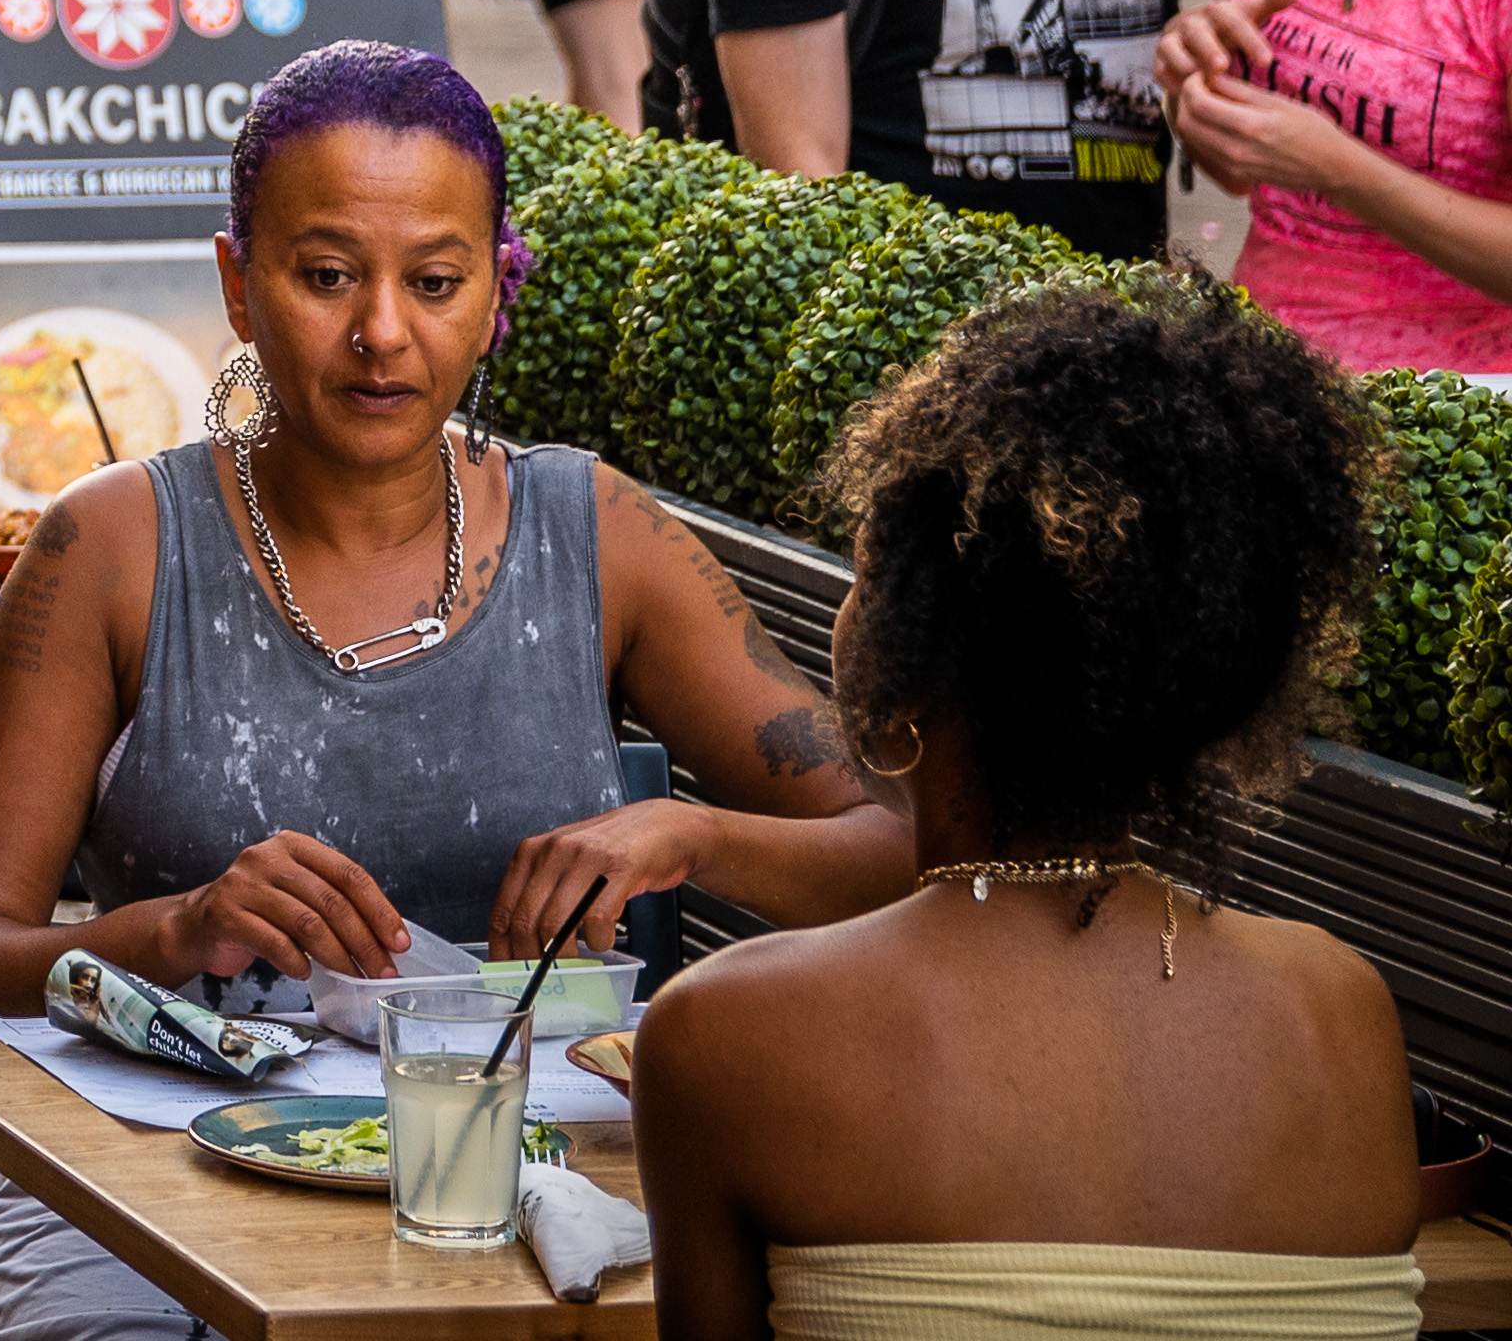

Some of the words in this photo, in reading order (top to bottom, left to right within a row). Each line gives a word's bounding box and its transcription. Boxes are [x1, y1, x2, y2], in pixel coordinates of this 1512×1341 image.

[103, 167, 213, 194] MOROCCAN
[151, 1019, 183, 1051] Don't
[185, 1043, 202, 1063] let
